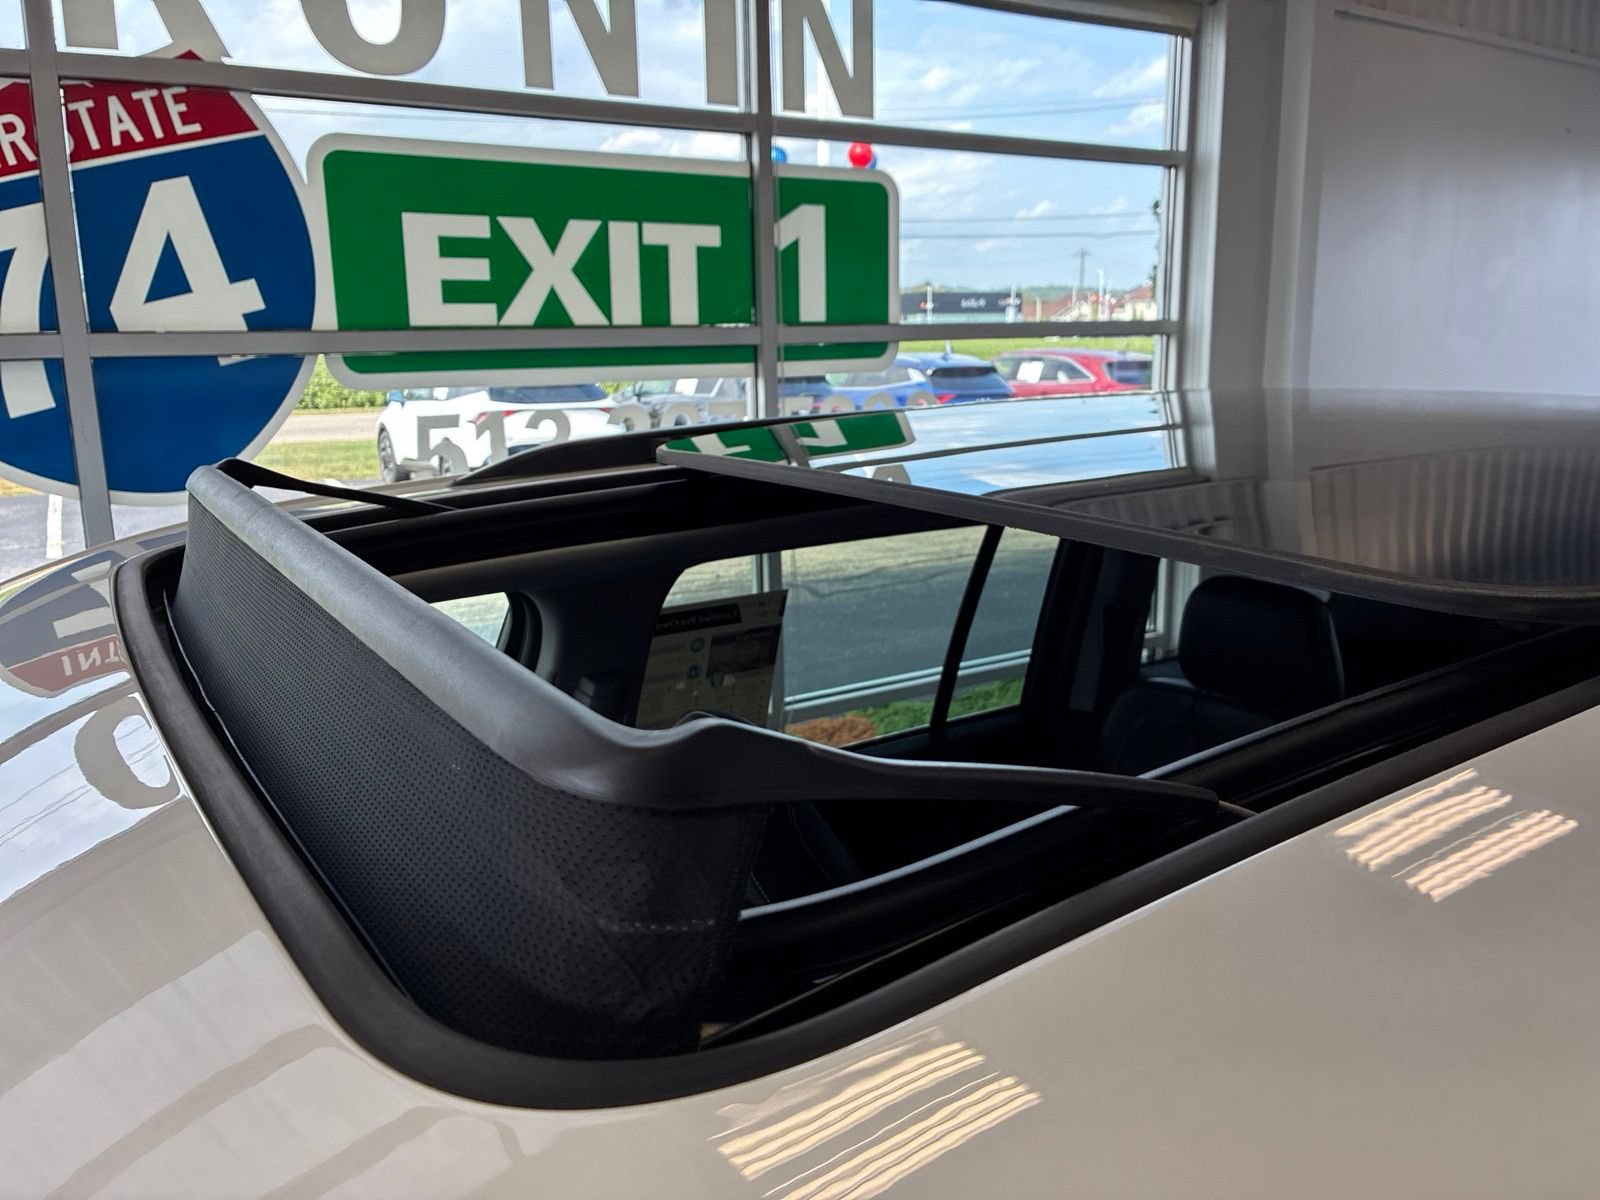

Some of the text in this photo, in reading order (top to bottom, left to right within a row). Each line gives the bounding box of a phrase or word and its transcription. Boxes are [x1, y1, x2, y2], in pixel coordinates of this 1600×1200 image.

[0, 86, 202, 167] RTATE
[0, 175, 266, 419] 74
[402, 204, 826, 327] EXIT 1
